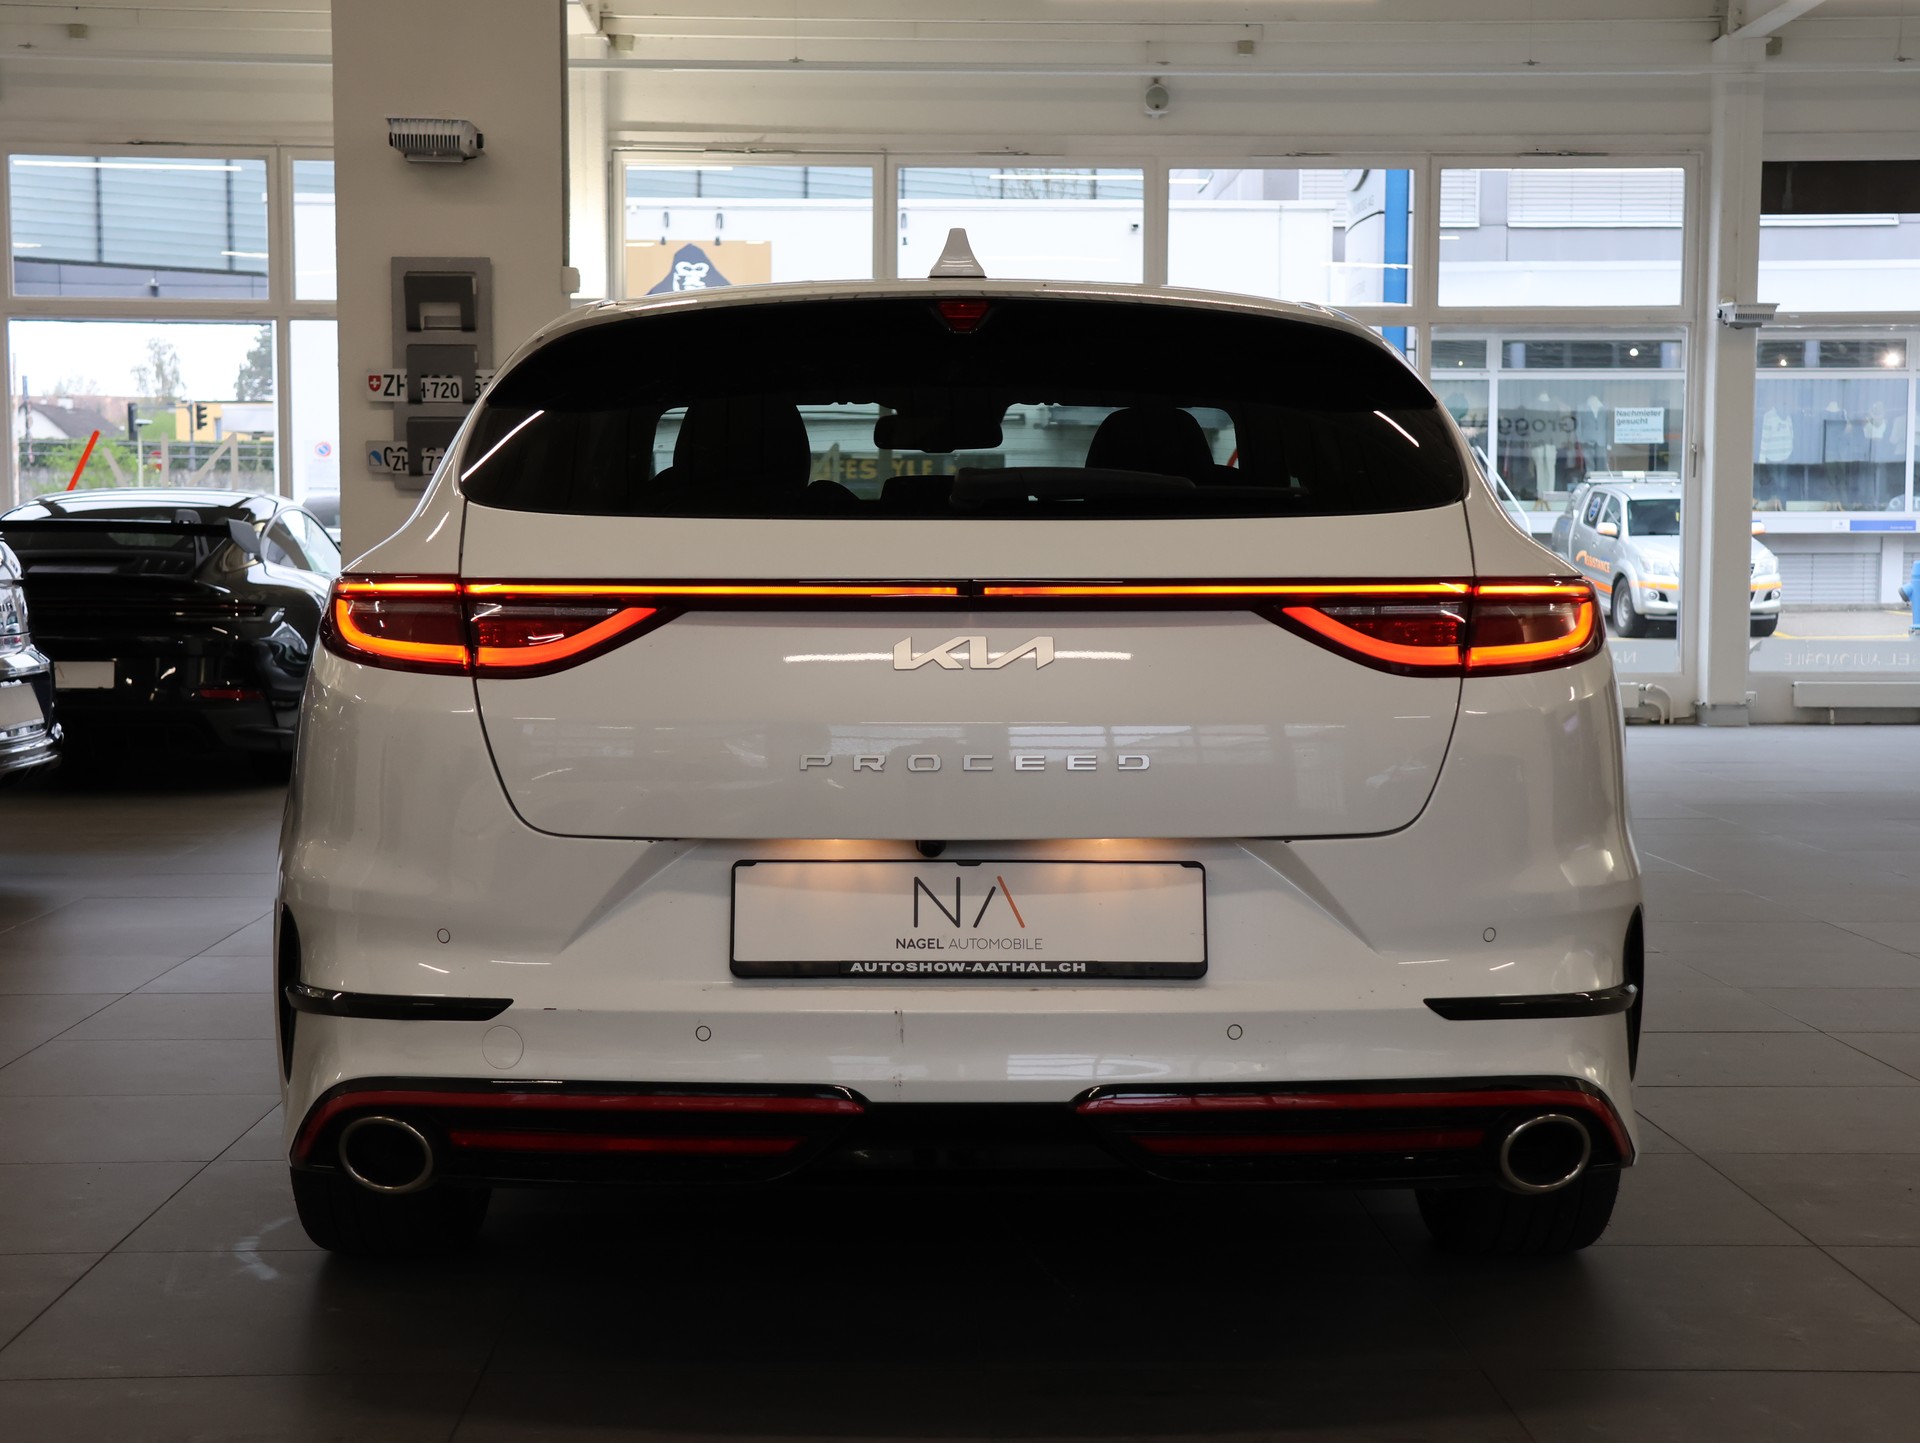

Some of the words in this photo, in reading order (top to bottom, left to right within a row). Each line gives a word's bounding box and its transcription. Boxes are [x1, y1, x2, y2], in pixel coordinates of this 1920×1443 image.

[1616, 409, 1661, 417] Nachmieter
[1616, 417, 1648, 426] gesucht
[893, 636, 1055, 670] KIA
[800, 754, 1151, 772] PROCEED
[896, 938, 944, 950] NAGEL
[949, 938, 1043, 950] AUTOMOBILE
[850, 961, 1087, 973] AUTOSHOW-AATHAL.CH
